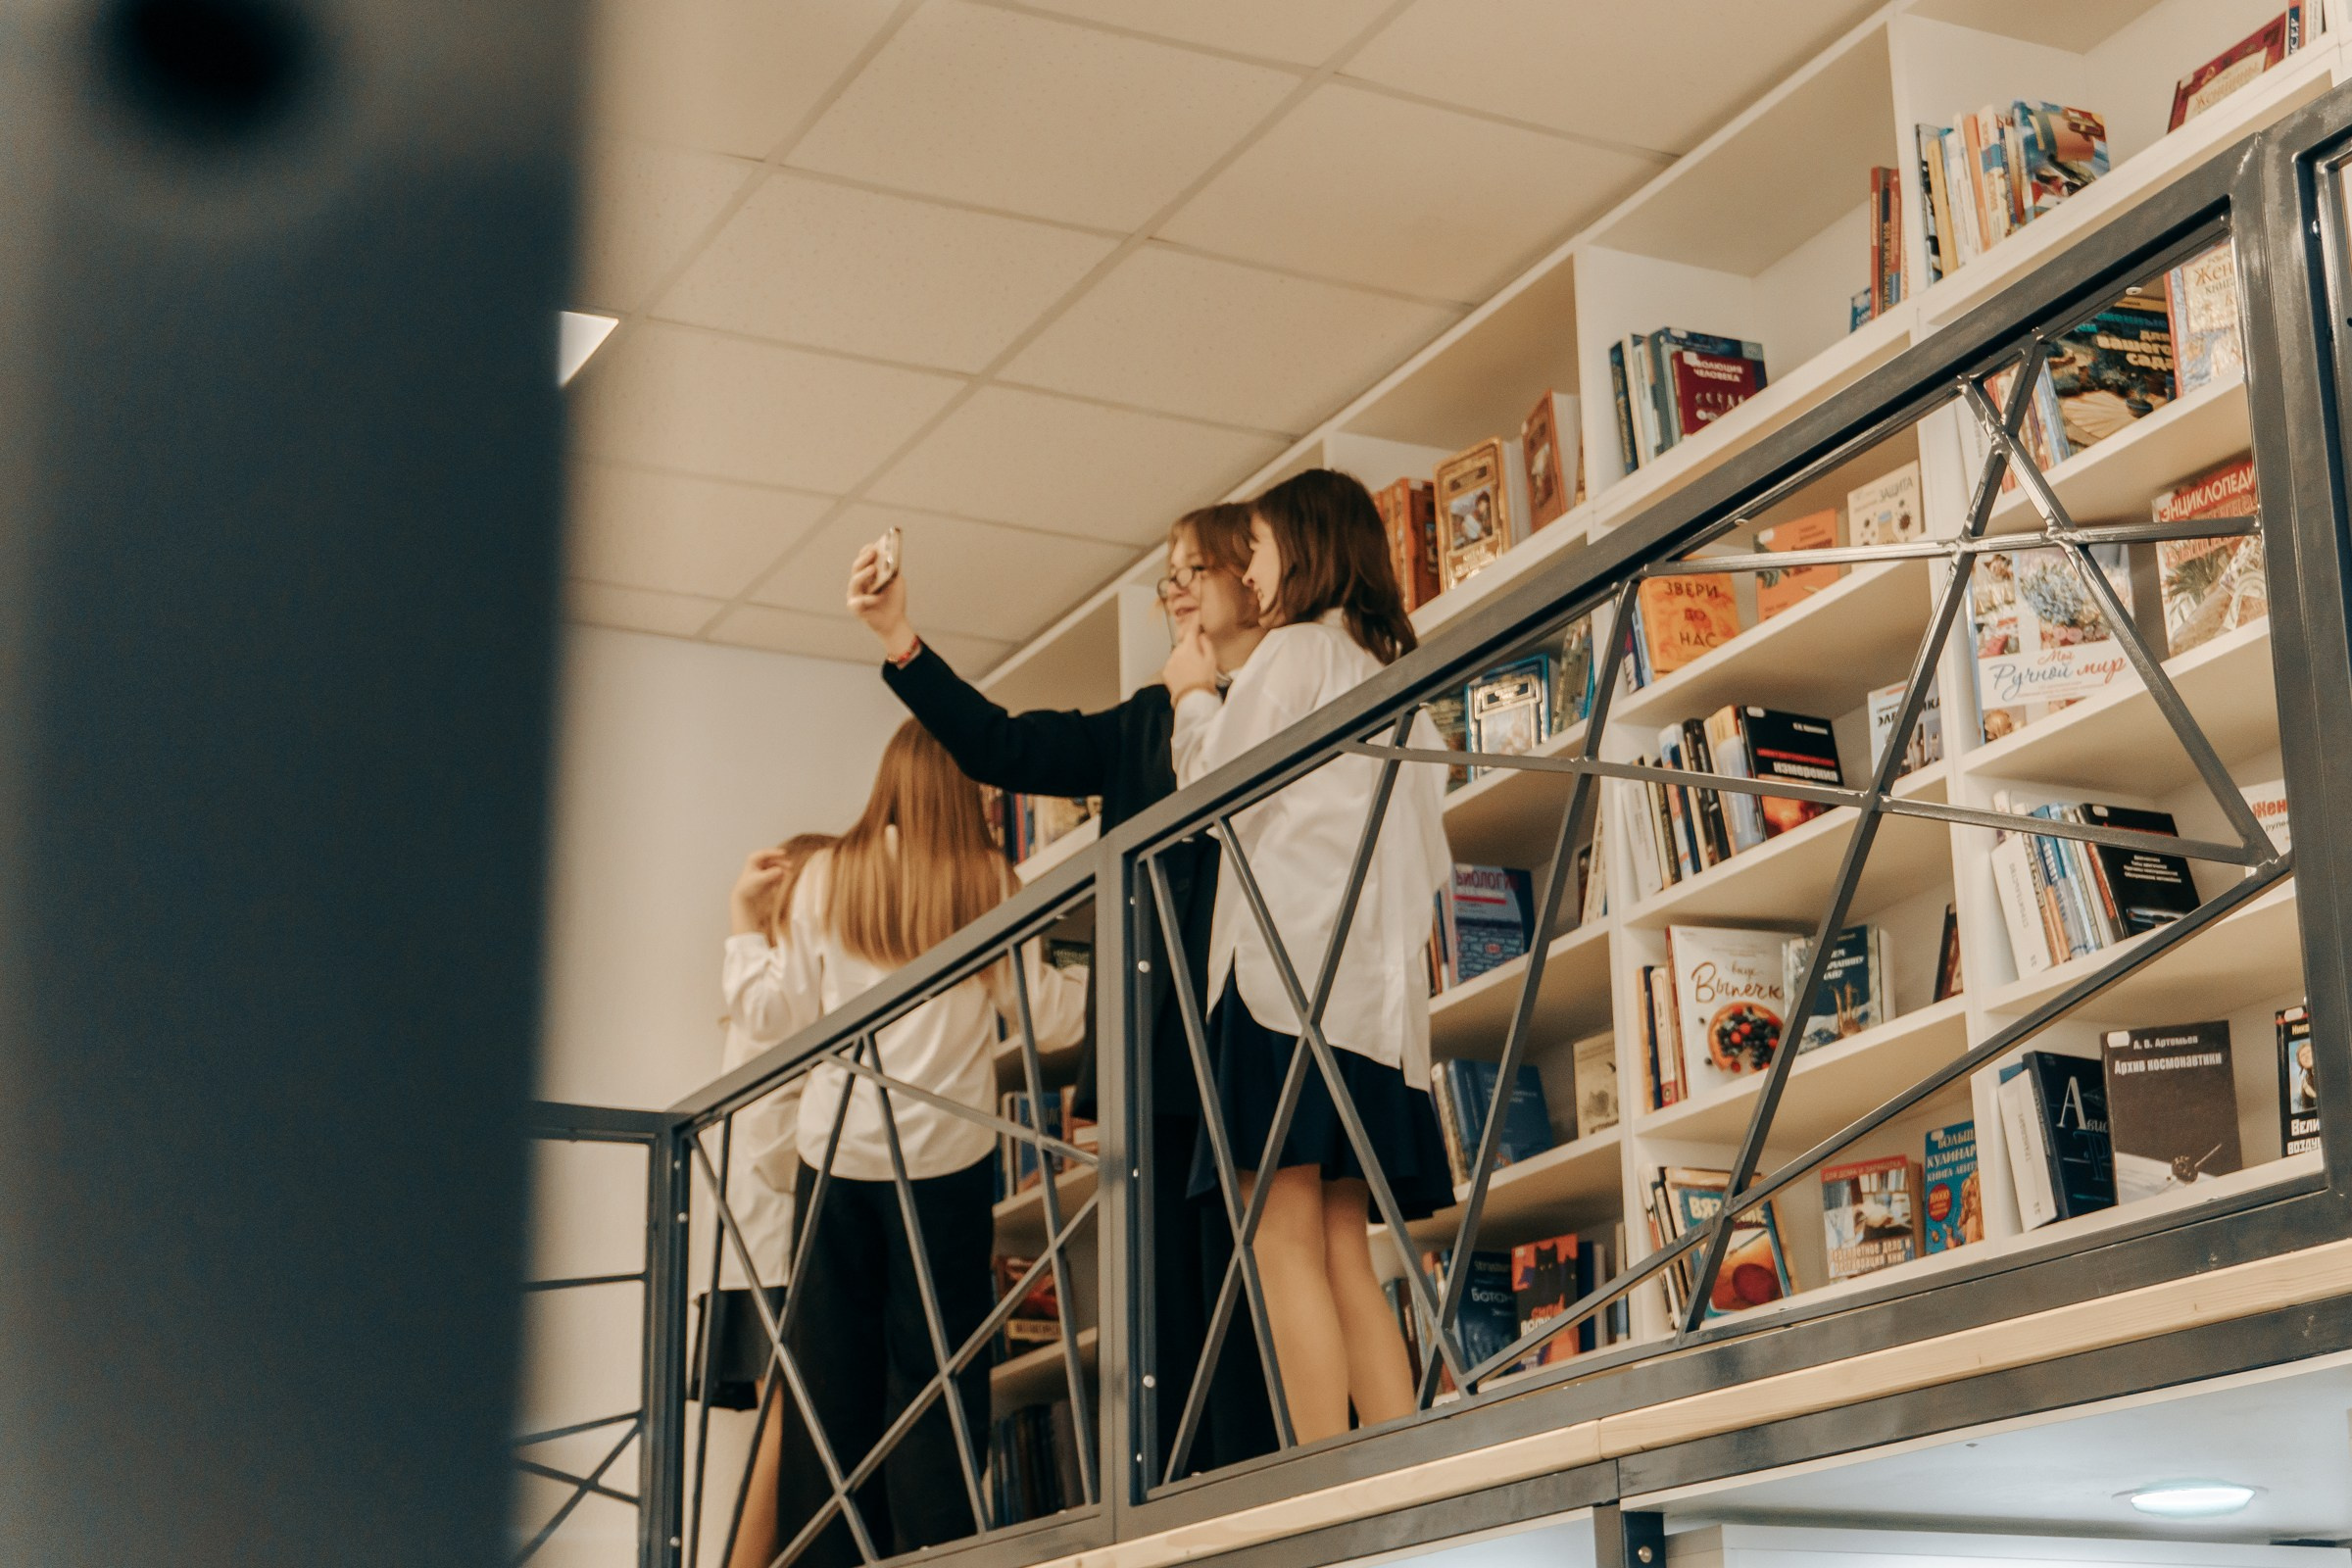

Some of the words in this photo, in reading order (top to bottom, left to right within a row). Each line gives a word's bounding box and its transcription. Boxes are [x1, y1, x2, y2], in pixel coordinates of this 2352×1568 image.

[1665, 580, 1720, 600] ЗВЕРИ
[1679, 630, 1718, 650] НАС
[1988, 662, 2073, 703] Ручной
[2077, 657, 2127, 685] мир
[2133, 1039, 2142, 1051] А.
[2144, 1038, 2153, 1049] В.
[2155, 1035, 2199, 1049] Артемьев
[2115, 1059, 2145, 1076] Архив
[2147, 1052, 2223, 1072] космонавтики
